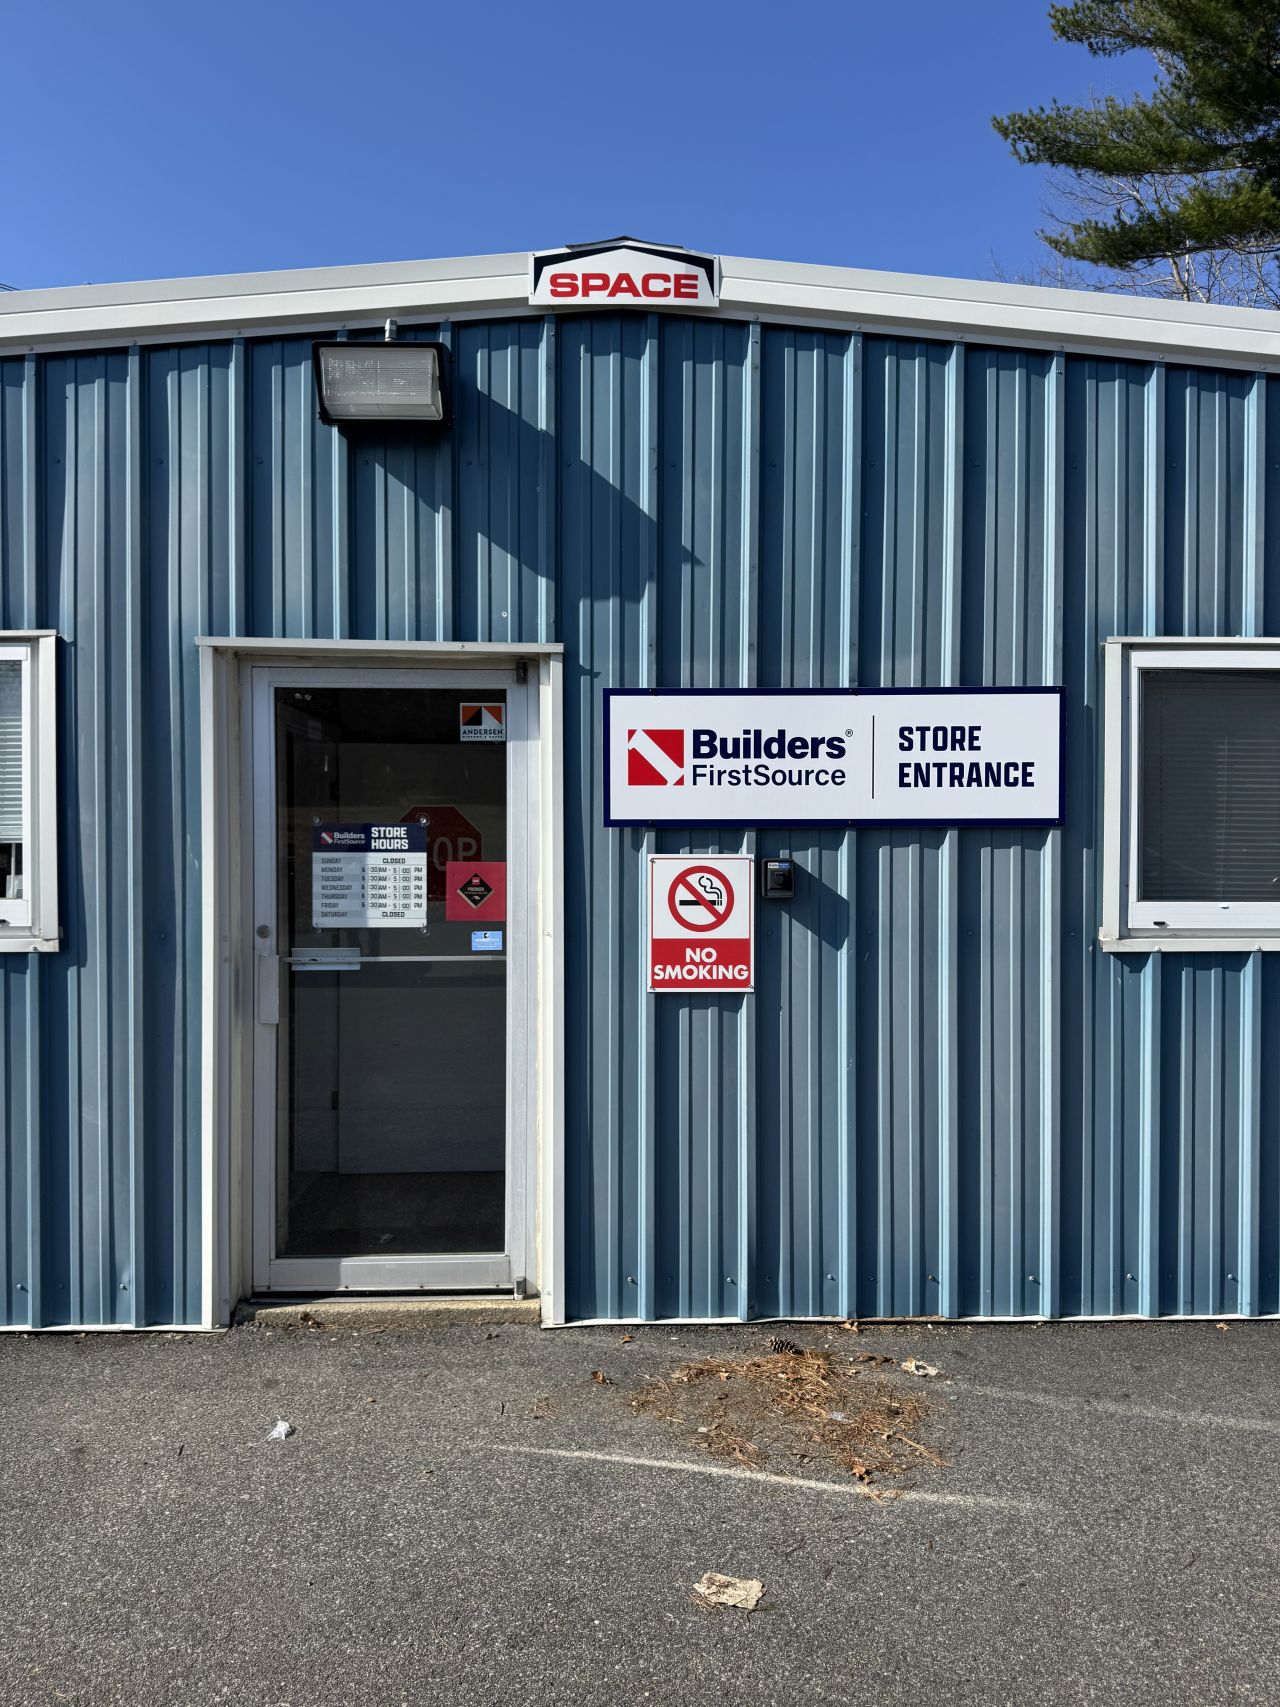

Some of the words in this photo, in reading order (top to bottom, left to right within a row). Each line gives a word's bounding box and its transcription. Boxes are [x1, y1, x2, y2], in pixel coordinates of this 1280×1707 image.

[549, 272, 699, 299] SPACE
[898, 725, 982, 752] STORE
[692, 764, 846, 787] FirstSource
[898, 761, 1035, 788] ENTRANCE
[371, 827, 408, 838] STORE
[371, 839, 408, 850] HOURS
[684, 947, 717, 963] NO
[653, 964, 748, 980] SMOKING
